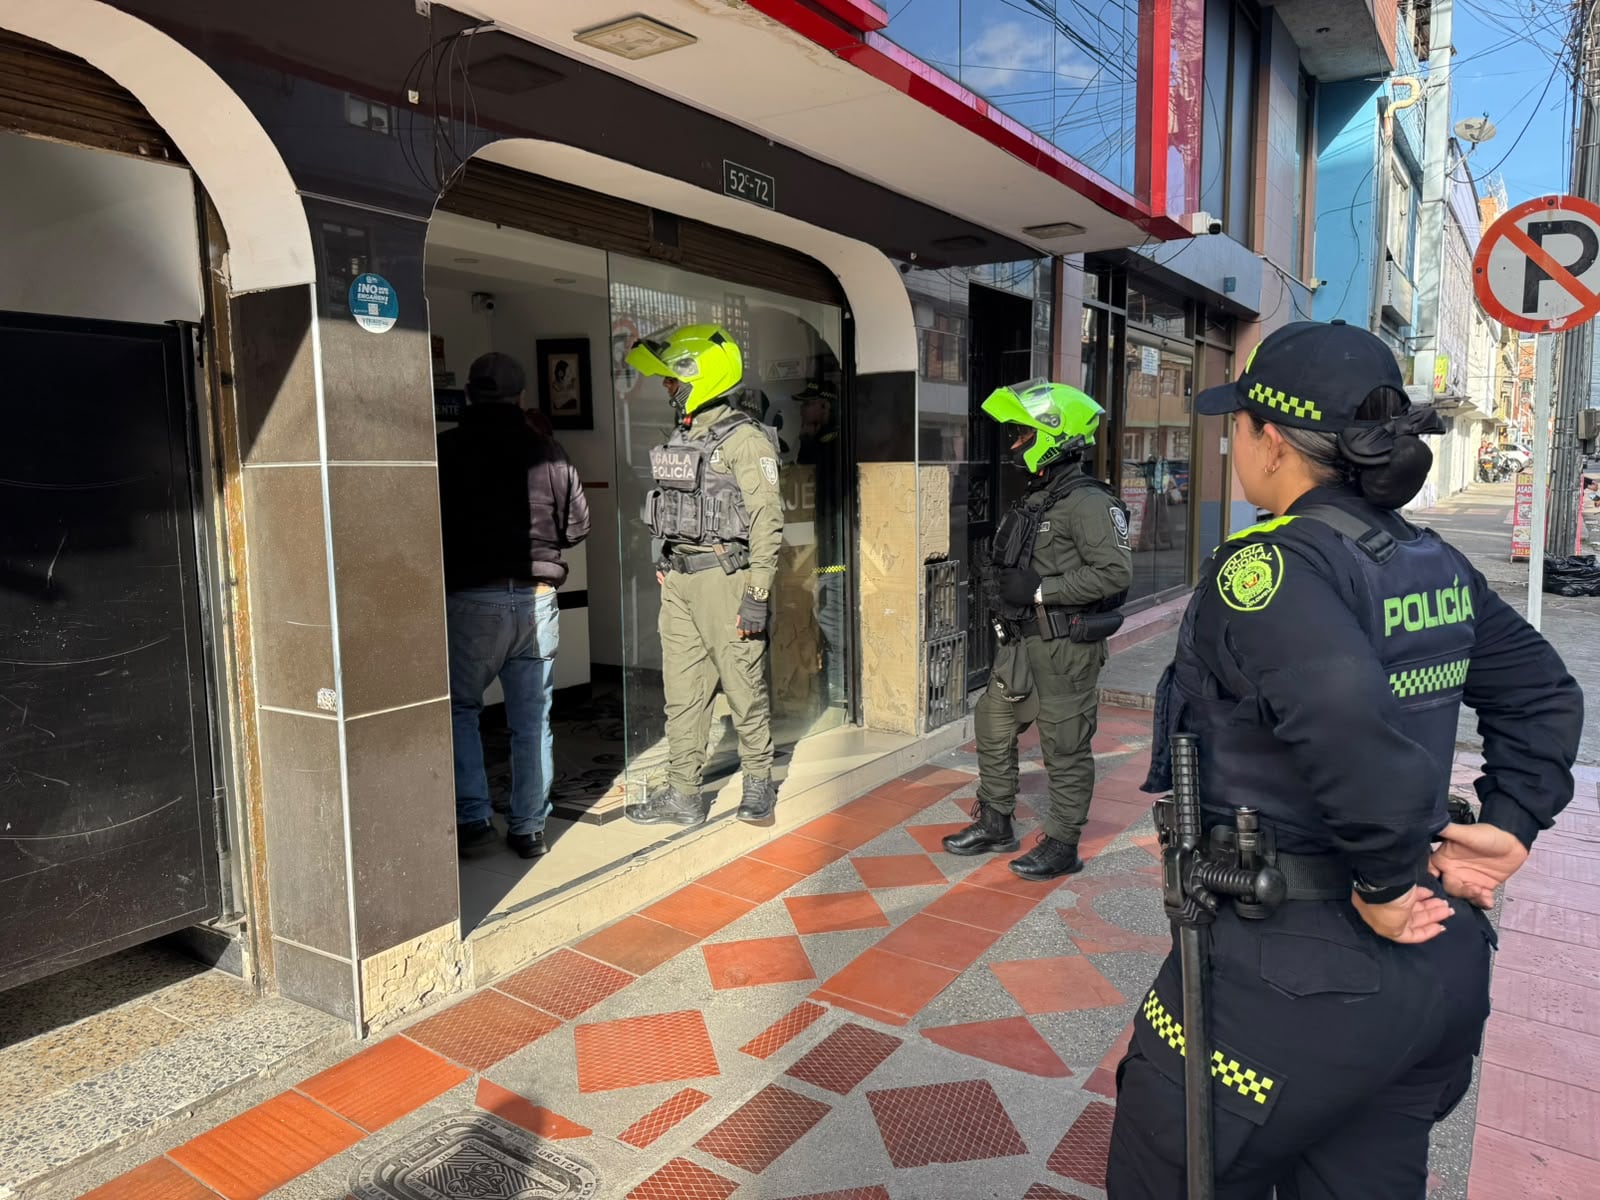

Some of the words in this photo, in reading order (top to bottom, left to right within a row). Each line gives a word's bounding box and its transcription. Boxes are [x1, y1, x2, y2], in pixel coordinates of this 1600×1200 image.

[653, 463, 696, 479] POLICÍA
[655, 452, 692, 466] GAULA
[1223, 552, 1273, 591] NACIONAL
[1383, 573, 1475, 638] POLICÍA
